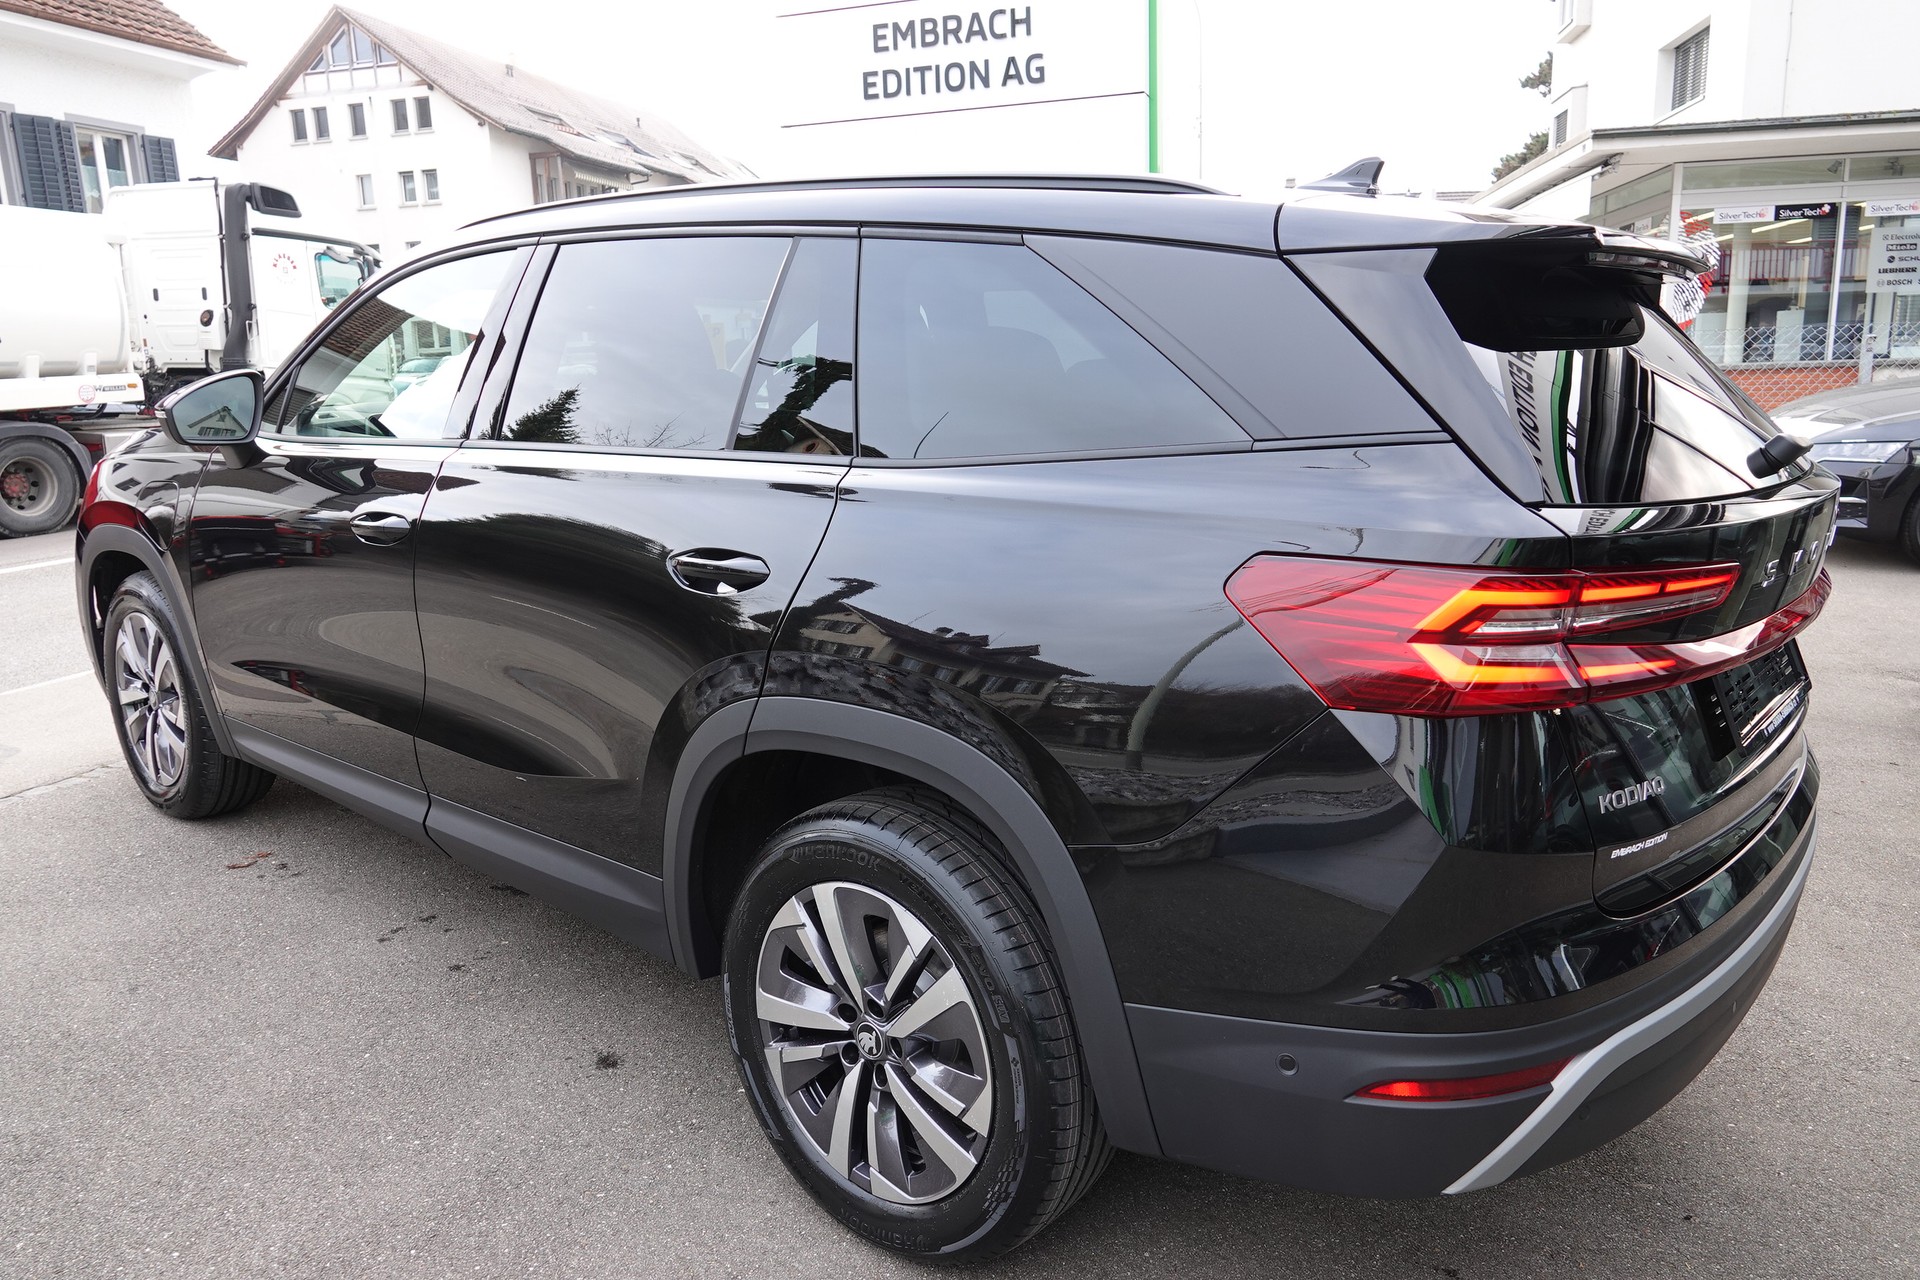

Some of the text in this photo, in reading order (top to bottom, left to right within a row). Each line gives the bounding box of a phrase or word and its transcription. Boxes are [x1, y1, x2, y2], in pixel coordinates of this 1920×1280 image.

[872, 6, 1033, 53] EMBRACH
[862, 53, 1046, 100] EDITION AG
[1719, 211, 1761, 220] SilverTech
[1778, 206, 1822, 218] SilverTech
[1870, 203, 1914, 214] SilverTech
[1598, 775, 1665, 815] KODIAQ
[1610, 832, 1669, 859] EMBRACH EDITION
